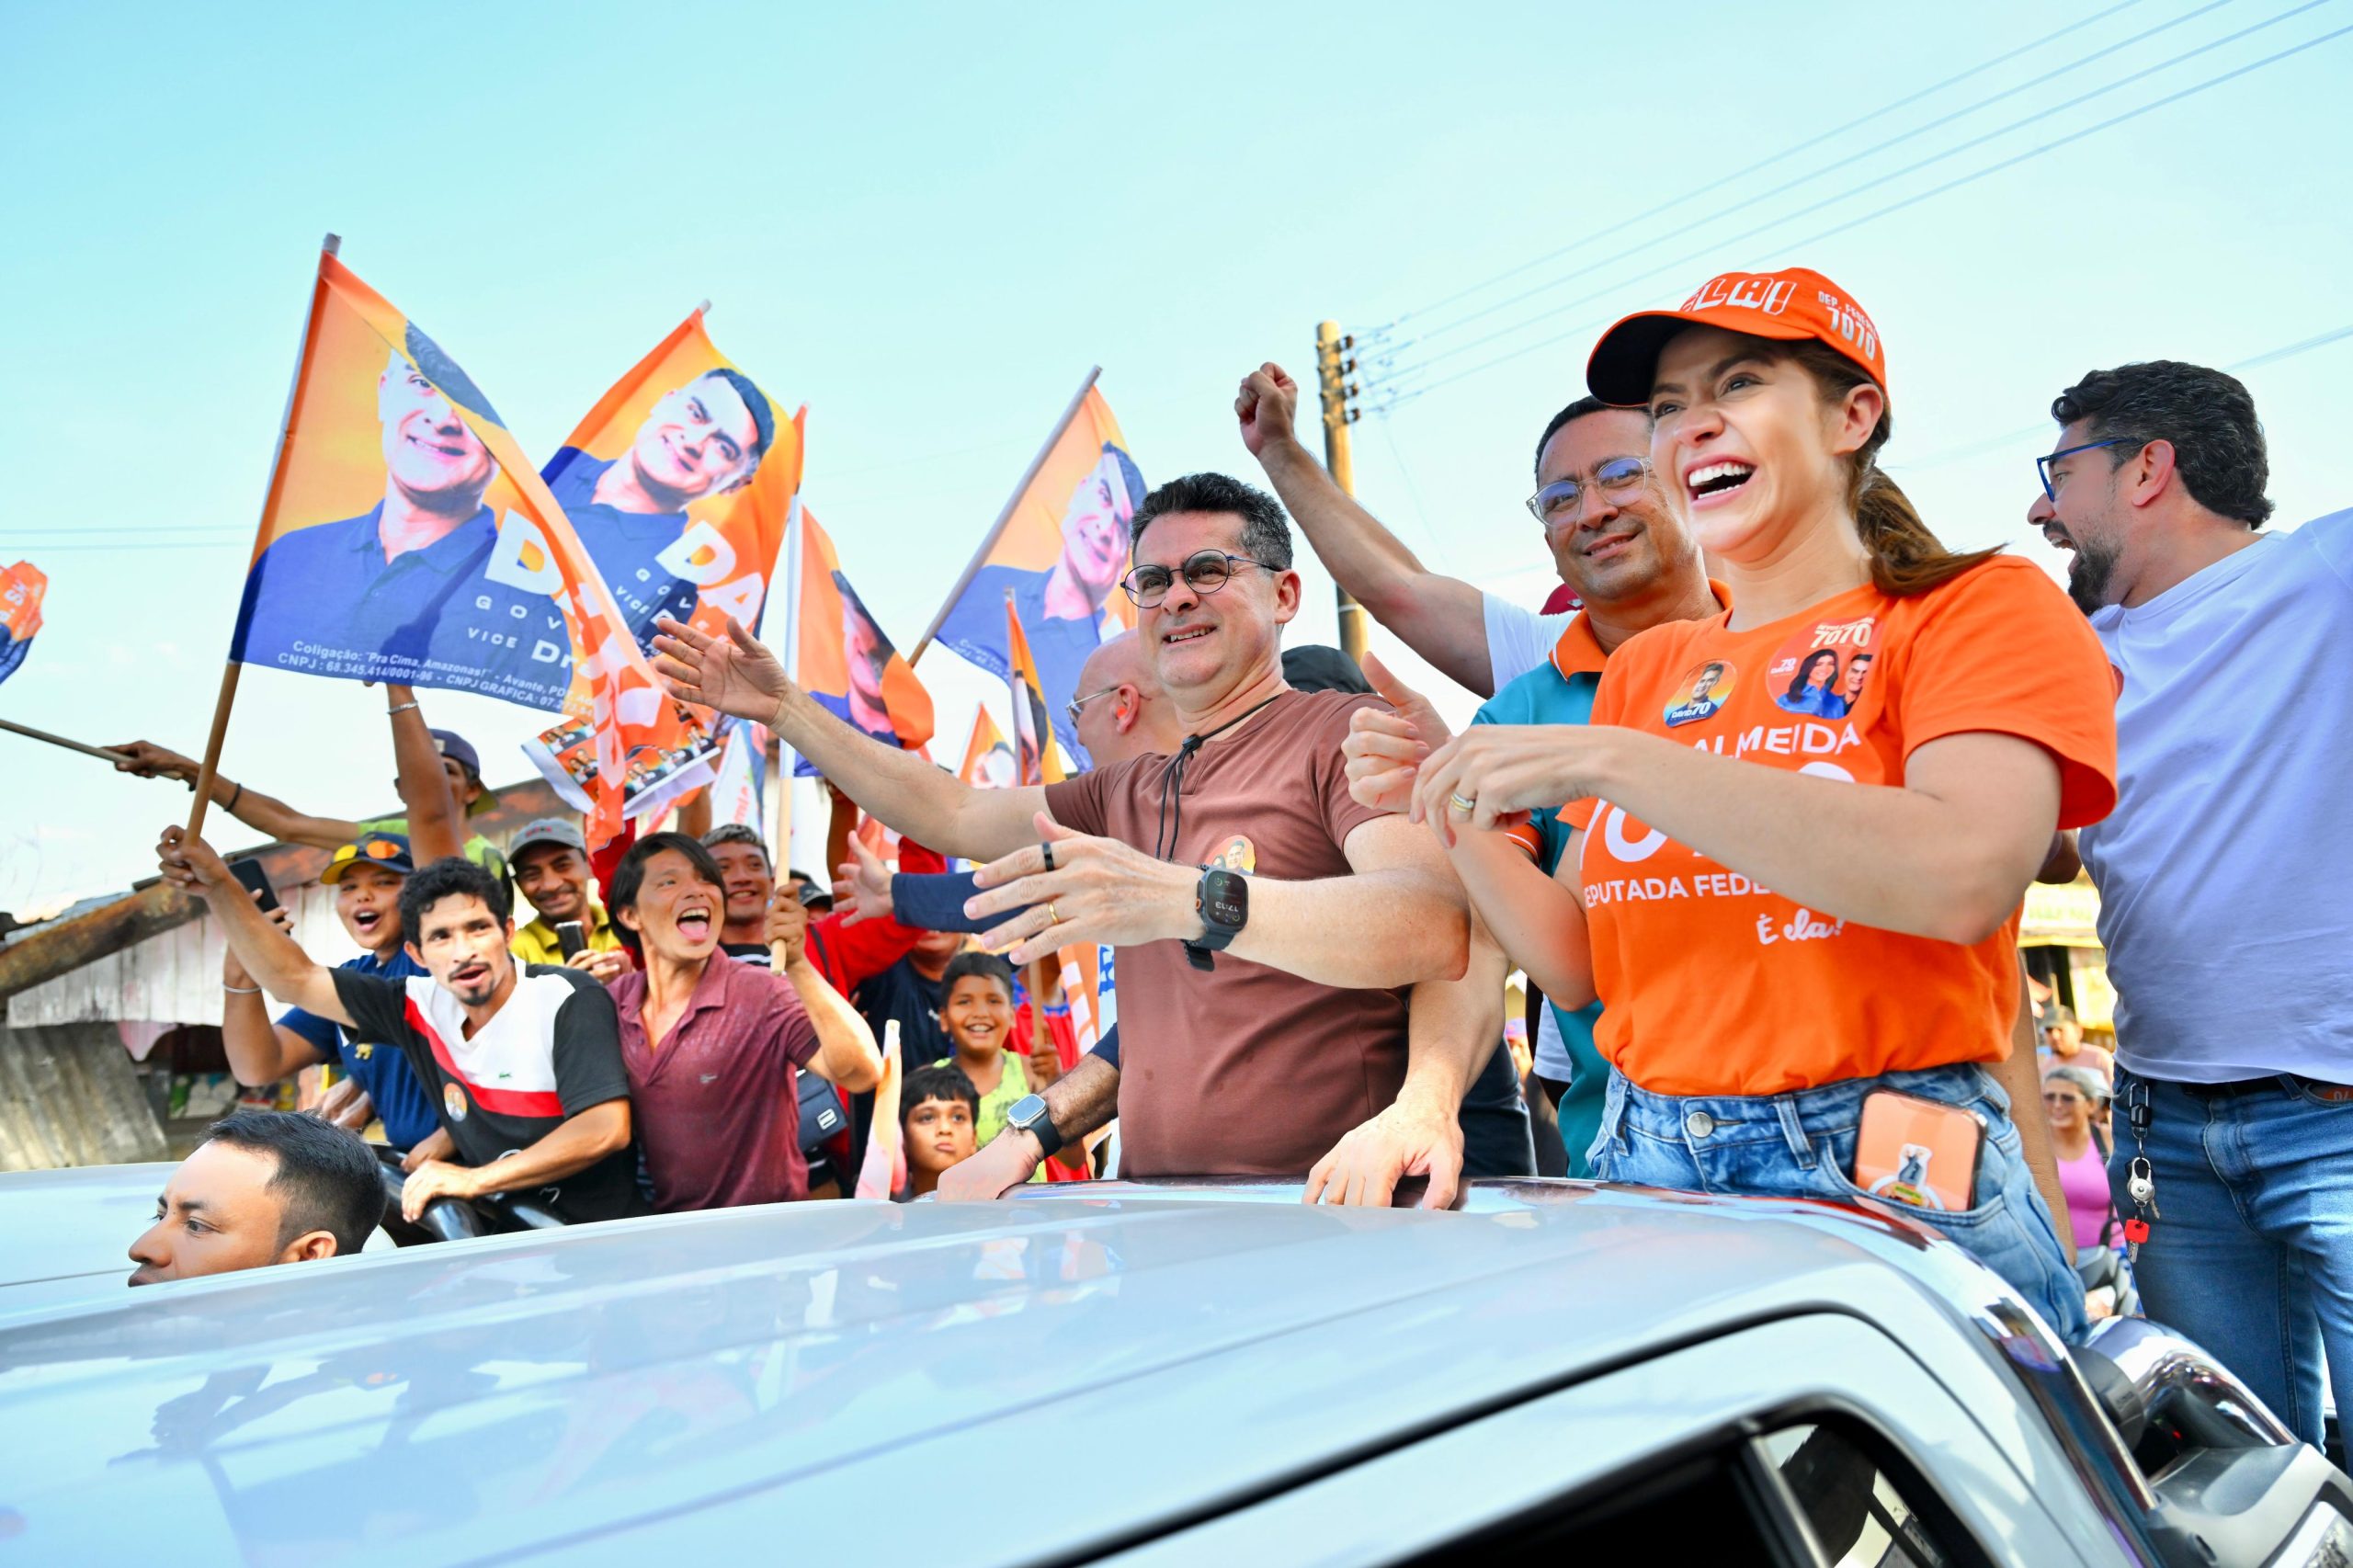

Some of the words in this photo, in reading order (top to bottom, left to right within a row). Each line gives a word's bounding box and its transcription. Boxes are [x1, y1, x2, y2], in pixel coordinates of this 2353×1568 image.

[1825, 306, 1876, 361] 7070
[467, 627, 518, 649] VICE
[1809, 622, 1871, 648] 7070
[292, 641, 363, 662] Coligação:
[278, 653, 317, 669] CNPJ
[446, 675, 479, 688] CNPJ
[1691, 701, 1712, 716] 70
[1756, 913, 1779, 946] É
